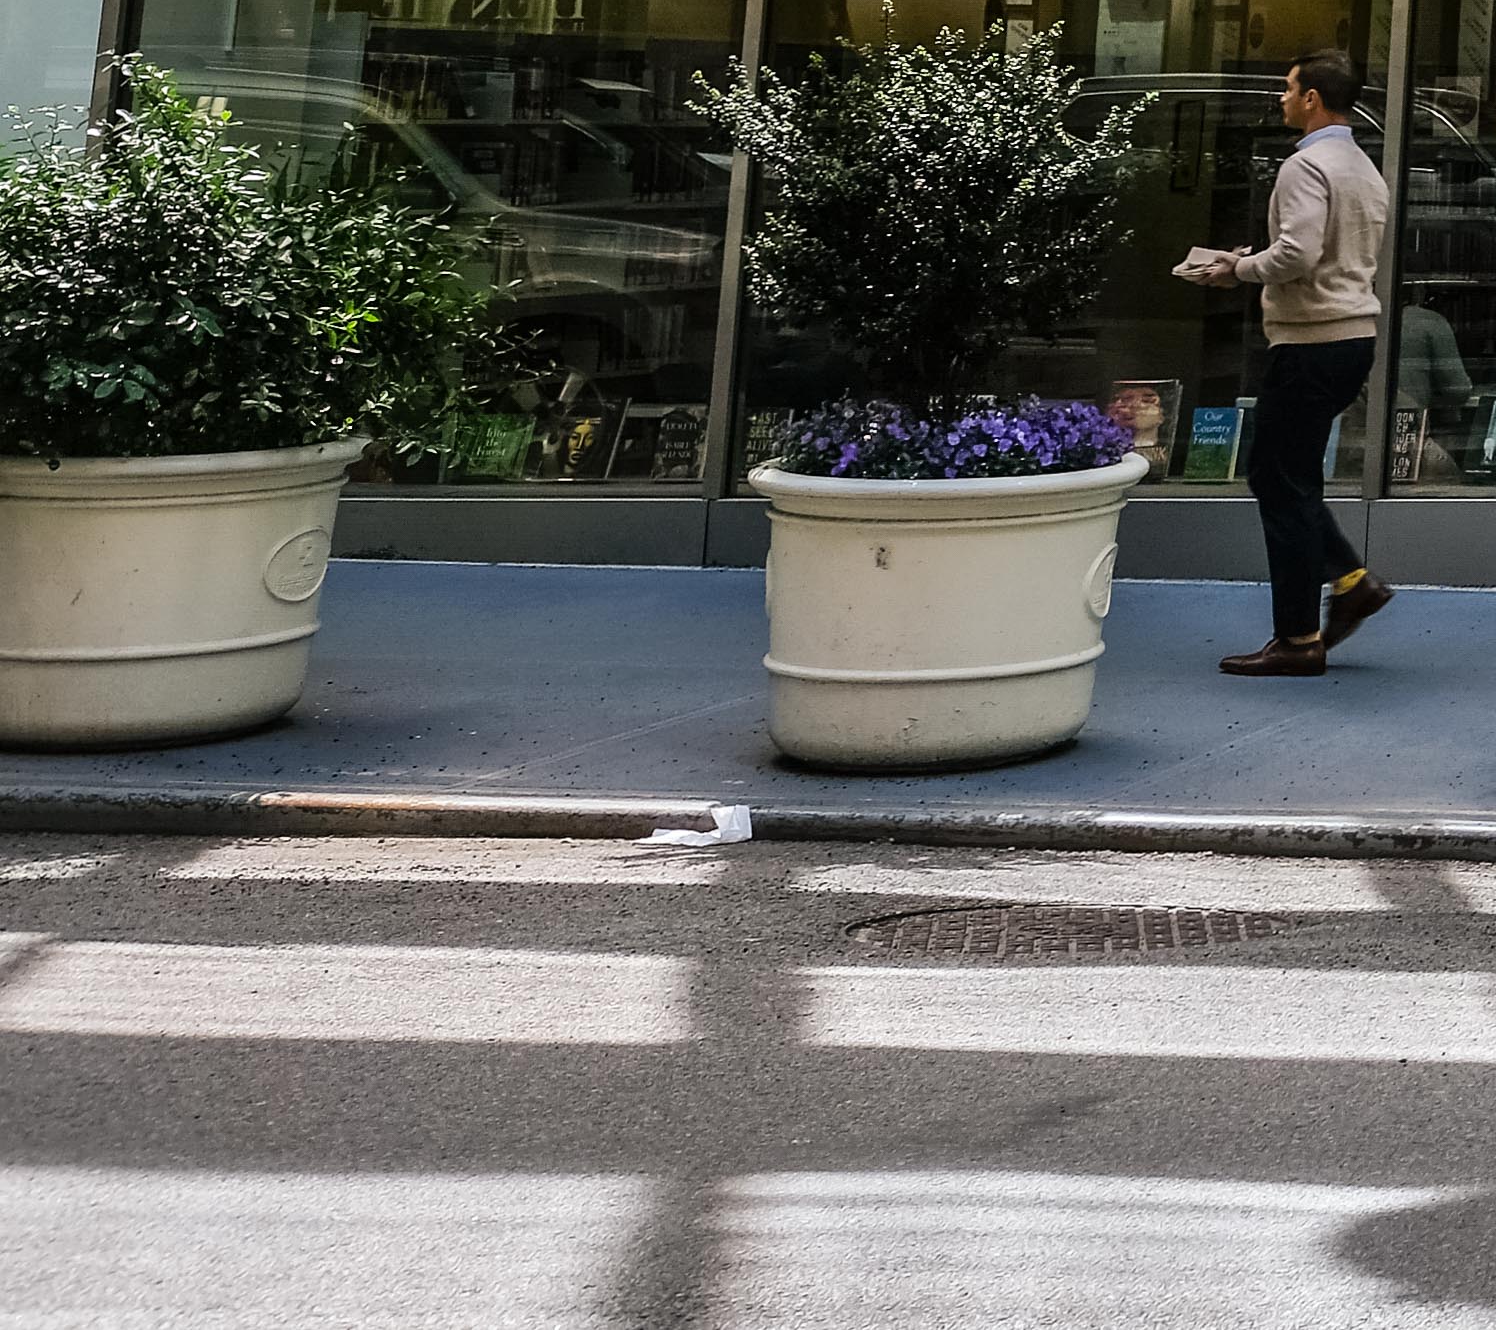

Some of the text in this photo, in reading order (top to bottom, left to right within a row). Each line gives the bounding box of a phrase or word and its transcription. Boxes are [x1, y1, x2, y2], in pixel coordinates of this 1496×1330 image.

[1204, 411, 1224, 421] Our
[1193, 422, 1233, 435] Country
[1193, 434, 1227, 445] Friends
